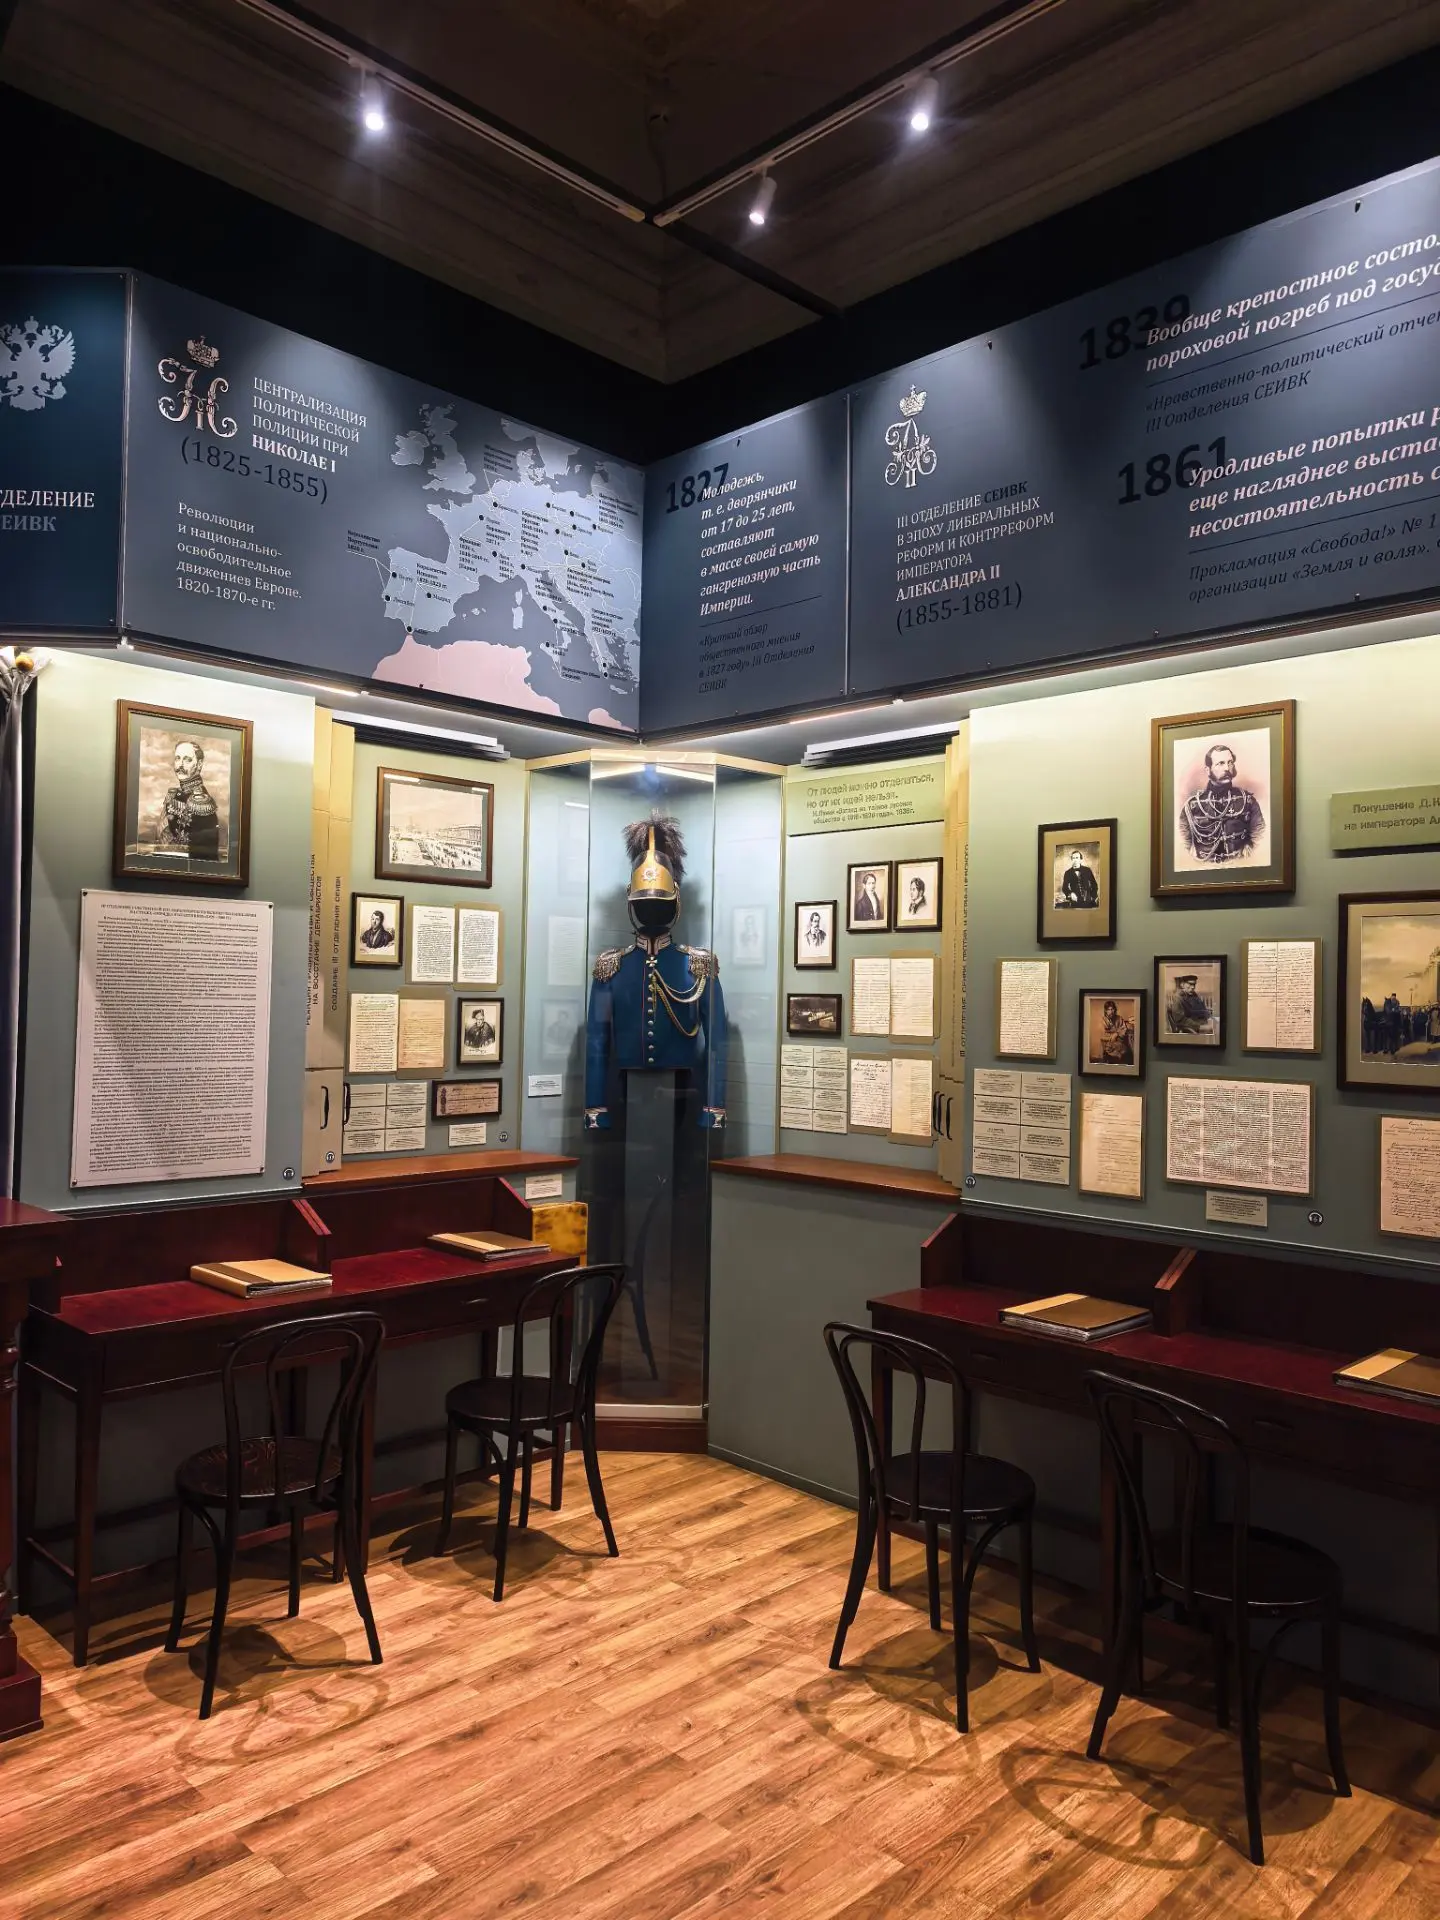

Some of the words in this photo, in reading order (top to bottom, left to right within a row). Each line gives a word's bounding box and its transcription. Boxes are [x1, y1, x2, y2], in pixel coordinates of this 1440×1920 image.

[1147, 308, 1222, 347] Вообще
[1226, 260, 1360, 319] крепостное
[1078, 294, 1191, 371] 1839
[1146, 322, 1249, 372] пороховой
[1255, 293, 1332, 336] погреб
[1335, 278, 1377, 309] под
[1146, 324, 1385, 412] «Нравственно-политический
[252, 395, 360, 443] ПОЛИТИЧЕСКОЙ
[253, 377, 368, 428] ЦЕНТРАЛИЗАЦИЯ
[1164, 391, 1249, 428] Отделения
[1254, 370, 1312, 400] СЕИВК
[252, 414, 319, 448] ПОЛИЦИИ
[322, 438, 349, 457] ПРИ
[252, 433, 328, 470] НИКОЛАЕ
[1311, 410, 1426, 454] попытки
[181, 436, 328, 505] (1825-1855)
[665, 462, 729, 514] 1827
[701, 472, 765, 501] Молодежь,
[1117, 435, 1227, 505] 1861
[1189, 490, 1229, 512] еще
[1233, 459, 1349, 502] нагляднее
[1354, 436, 1440, 471] выста
[0, 489, 95, 508] ДЕЛЕНИЕ
[178, 502, 255, 535] Революции
[701, 508, 714, 520] т.
[716, 504, 725, 515] е.
[727, 479, 797, 512] дворянчики
[701, 527, 717, 539] от
[720, 518, 733, 534] 17
[735, 514, 749, 528] до
[751, 507, 766, 523] 25
[767, 500, 796, 519] лет,
[896, 516, 909, 529] III
[911, 495, 982, 525] ОТДЕЛЕНИЕ
[984, 481, 1028, 503] СЕИВК
[1189, 471, 1424, 539] несостоятельность
[177, 523, 187, 534] и
[190, 526, 283, 558] национально-
[896, 541, 945, 565] РЕФОРМ
[947, 539, 956, 551] И
[959, 512, 1054, 548] КОНТРРЕФОРМ
[897, 535, 904, 546] В
[906, 523, 945, 543] ЭПОХУ
[946, 497, 1041, 533] ЛИБЕРАЛЬНЫХ
[177, 542, 292, 579] освободительное
[700, 567, 707, 578] в
[709, 557, 743, 575] массе
[744, 543, 777, 565] своей
[779, 534, 819, 556] самую
[701, 527, 775, 559] составляют
[1189, 547, 1297, 581] Прокламация
[1301, 524, 1396, 556] «Свобода!»
[1401, 517, 1424, 535] №
[1429, 513, 1437, 530] 1
[255, 577, 302, 599] Европе.
[700, 567, 780, 597] гангренозную
[782, 555, 821, 574] часть
[896, 552, 973, 582] ИМПЕРАТОРА
[896, 568, 986, 602] АЛЕКСАНДРА
[990, 565, 1001, 578] II
[1189, 570, 1288, 604] организации
[1292, 556, 1354, 580] «Земля
[1358, 554, 1369, 567] и
[1373, 541, 1430, 563] воля».
[176, 577, 259, 607] 1820-1870-е
[261, 599, 277, 611] гг.
[700, 593, 753, 616] Империи.
[896, 581, 1022, 636] (1855-1881)
[743, 623, 768, 637] обзор
[766, 632, 801, 648] мнения
[706, 664, 725, 677] 1827
[763, 645, 815, 664] Отделения
[806, 787, 819, 797] От
[1352, 801, 1415, 814] Покушение
[1343, 823, 1357, 831] на
[1360, 816, 1426, 829] императора
